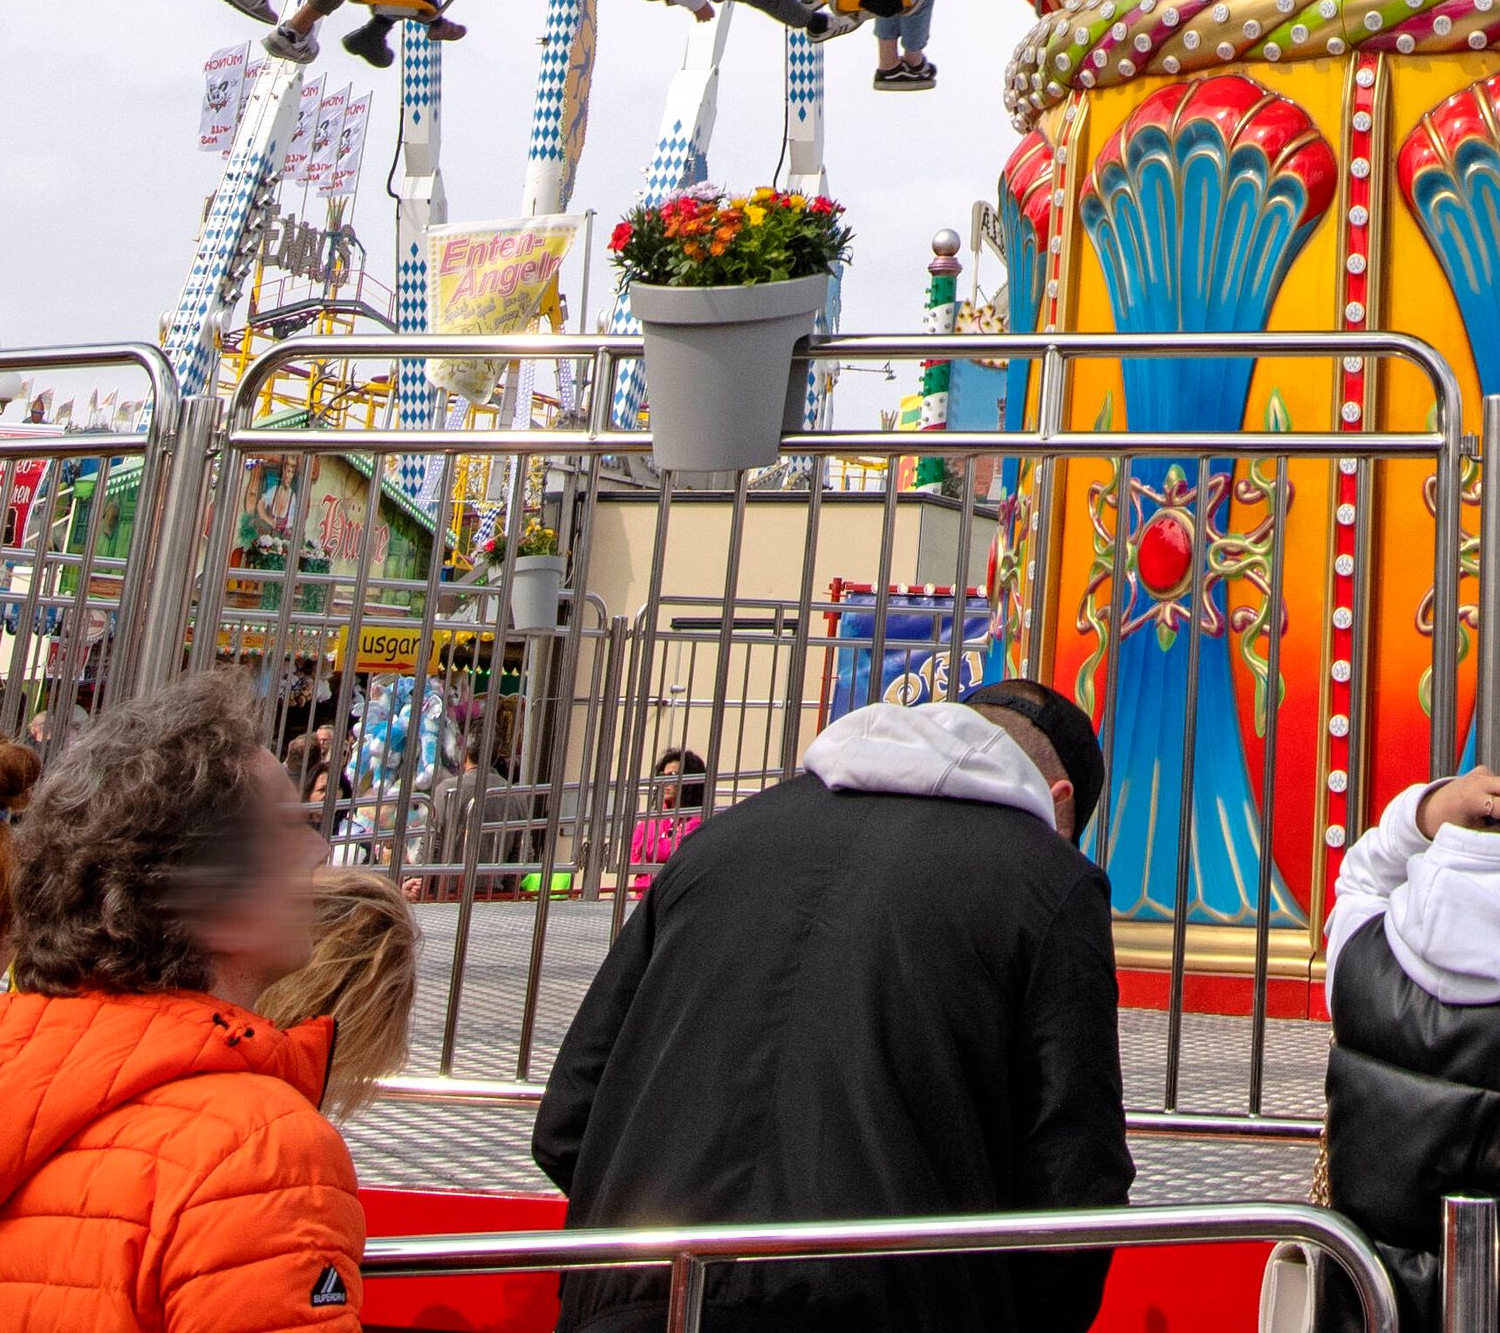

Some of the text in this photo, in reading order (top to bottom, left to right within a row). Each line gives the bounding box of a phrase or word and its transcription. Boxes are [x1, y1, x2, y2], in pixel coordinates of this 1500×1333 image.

[439, 231, 546, 277] Enten-
[444, 250, 563, 313] Angeln
[318, 494, 390, 565] Hüe
[346, 634, 436, 662] usga
